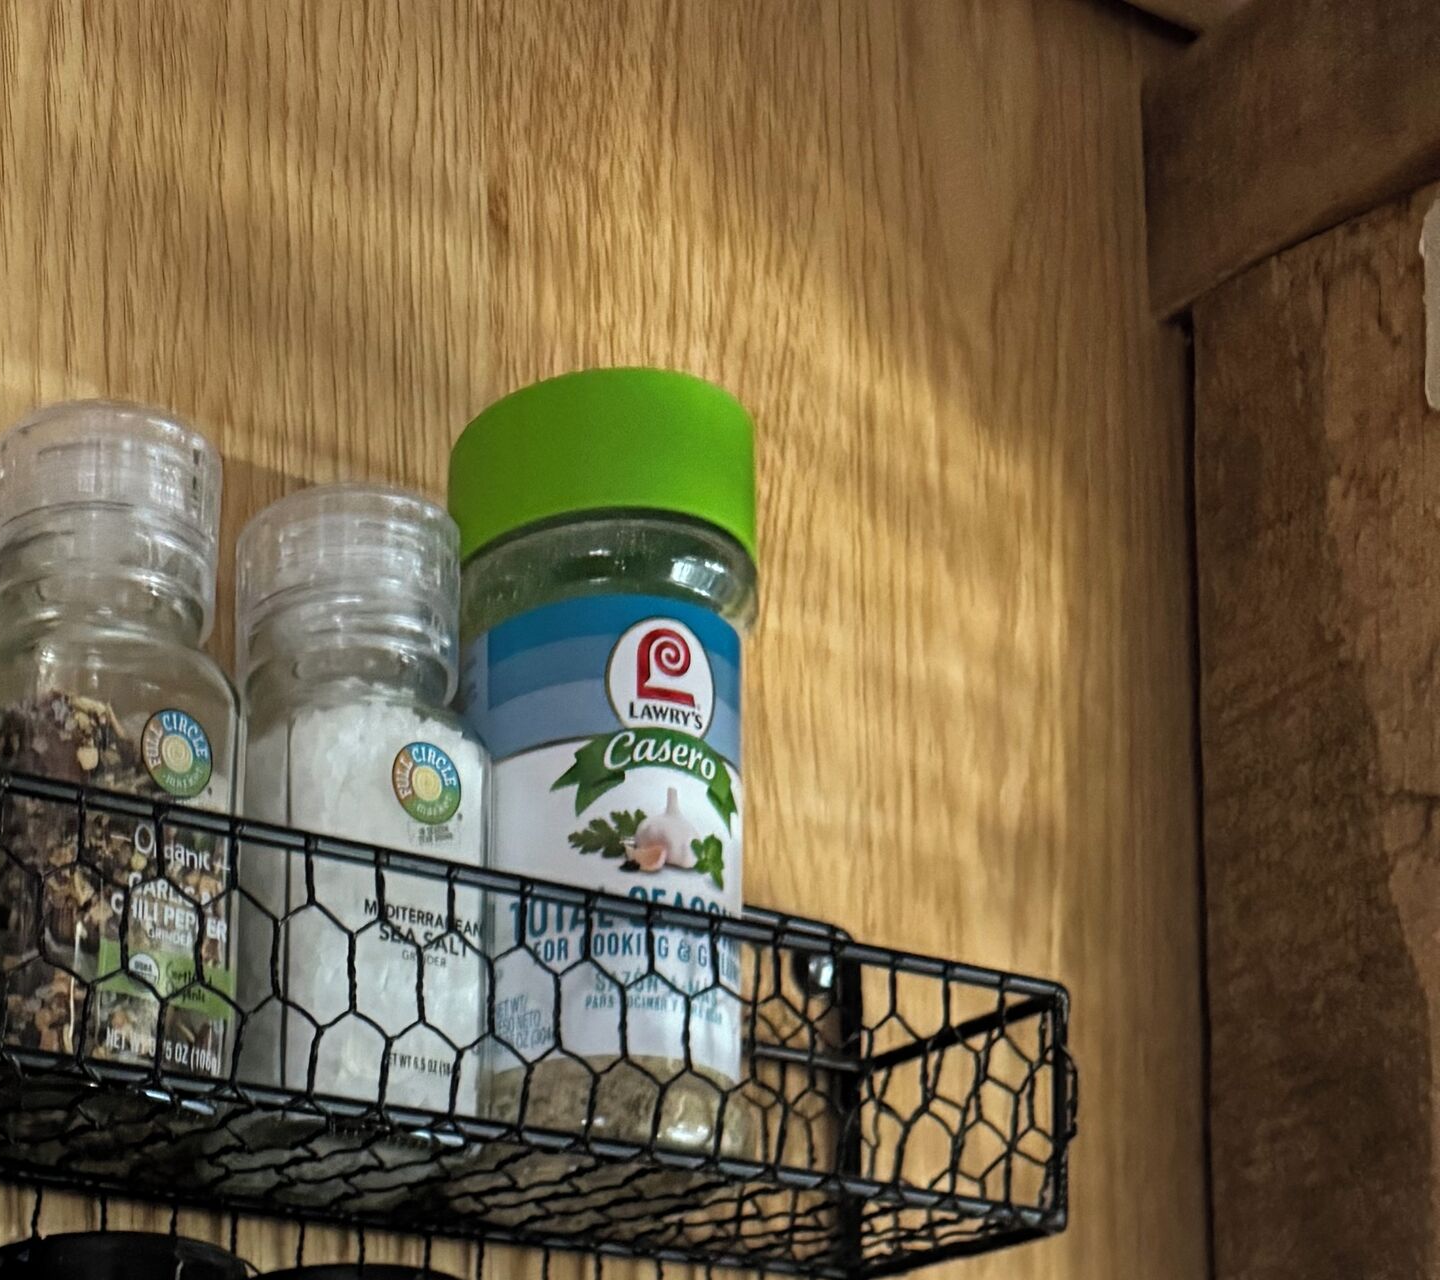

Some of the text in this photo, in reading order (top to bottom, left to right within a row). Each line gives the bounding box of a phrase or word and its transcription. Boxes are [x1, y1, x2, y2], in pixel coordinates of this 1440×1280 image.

[628, 700, 704, 730] LAWRY'S
[162, 713, 209, 759] CIRCLE
[411, 746, 458, 787] CIRCLE
[603, 731, 717, 781] Casero
[379, 922, 468, 958] SEA SALT
[106, 1026, 126, 1051] NET
[175, 1042, 189, 1065] OZ
[400, 1054, 412, 1069] WT
